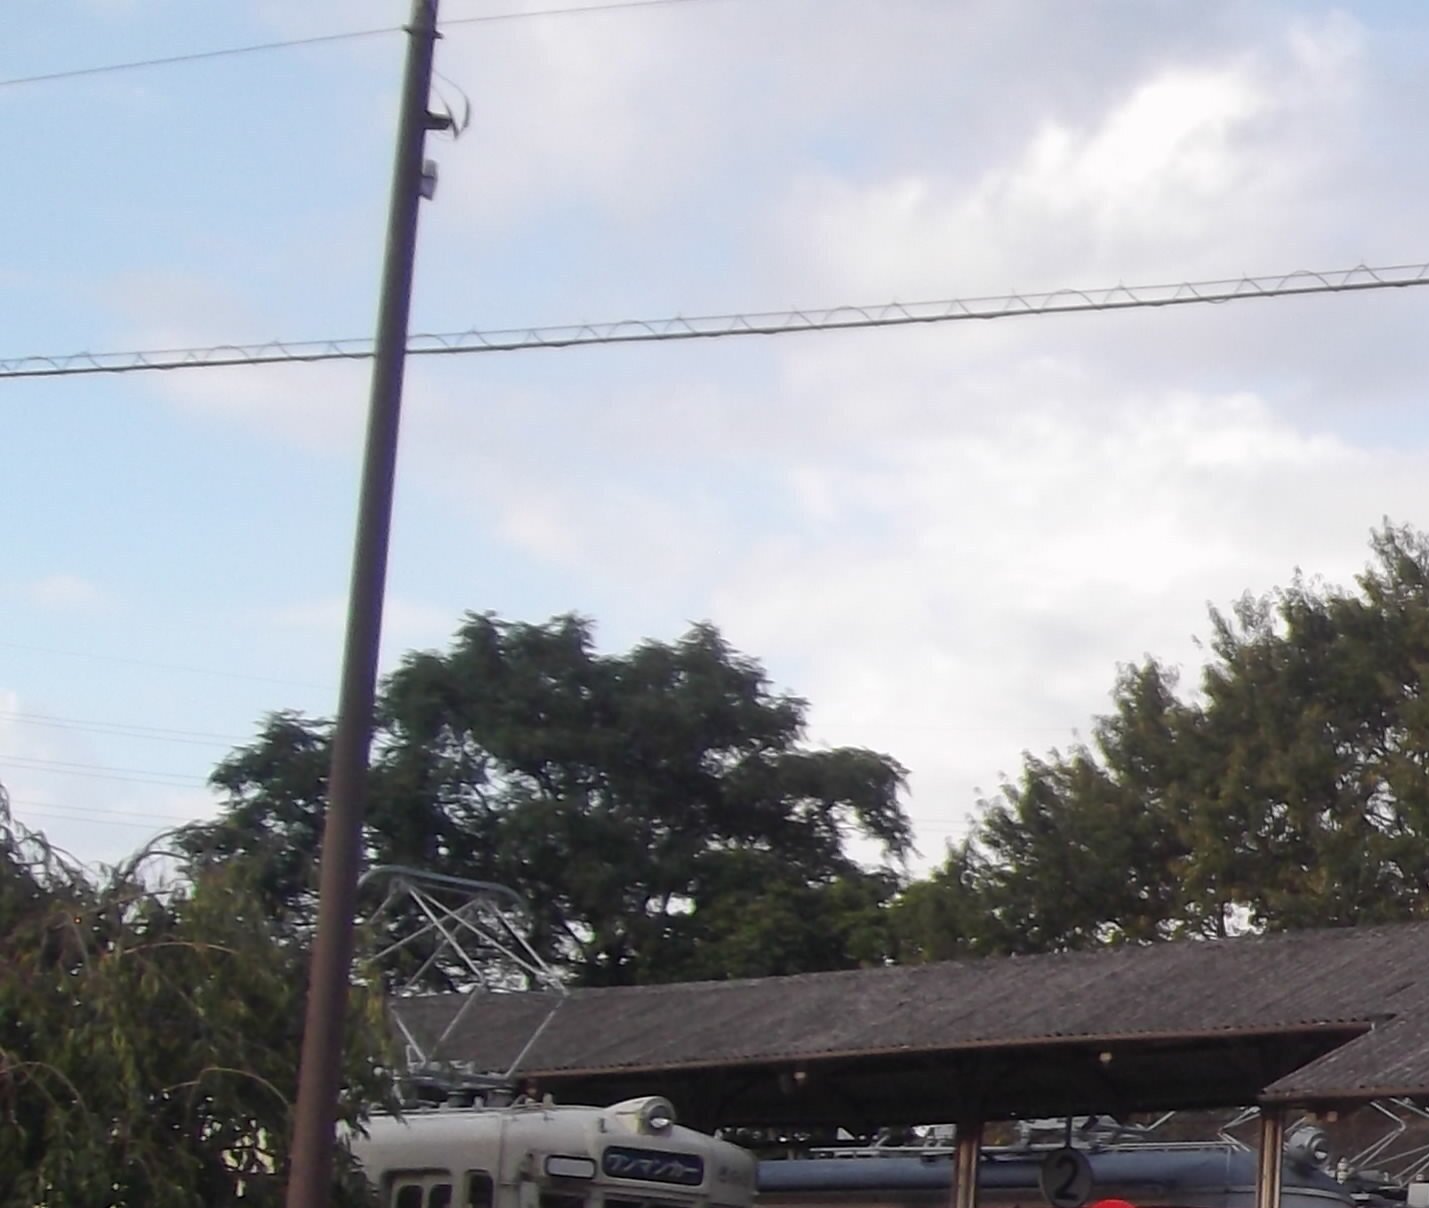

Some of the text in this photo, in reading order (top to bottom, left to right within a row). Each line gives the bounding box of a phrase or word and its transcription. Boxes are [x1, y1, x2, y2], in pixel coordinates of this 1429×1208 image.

[607, 1153, 700, 1177] ワンマンカー
[1055, 1155, 1079, 1199] 2
